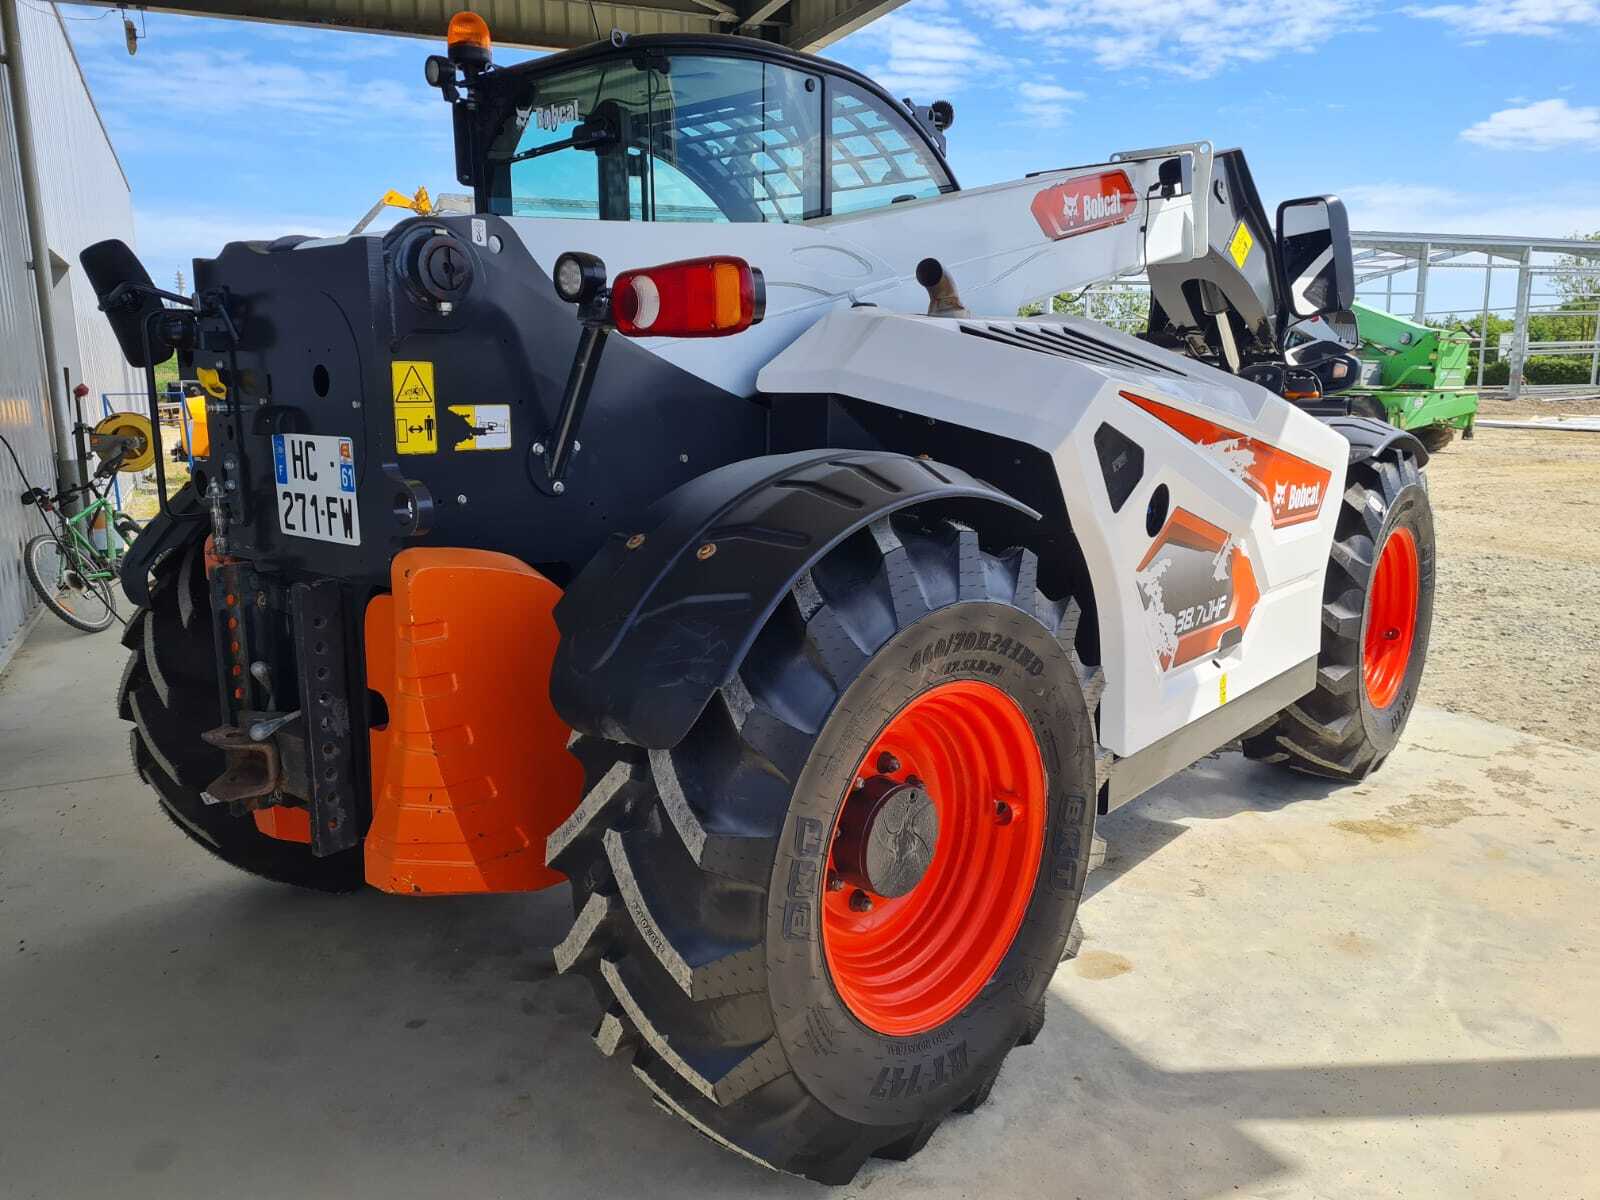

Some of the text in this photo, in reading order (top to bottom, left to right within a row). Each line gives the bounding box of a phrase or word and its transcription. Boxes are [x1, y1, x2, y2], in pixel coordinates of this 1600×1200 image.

[536, 99, 579, 132] Bobcat
[1083, 189, 1121, 221] Bobcat
[341, 467, 354, 487] 61
[1288, 481, 1320, 510] Bobcat
